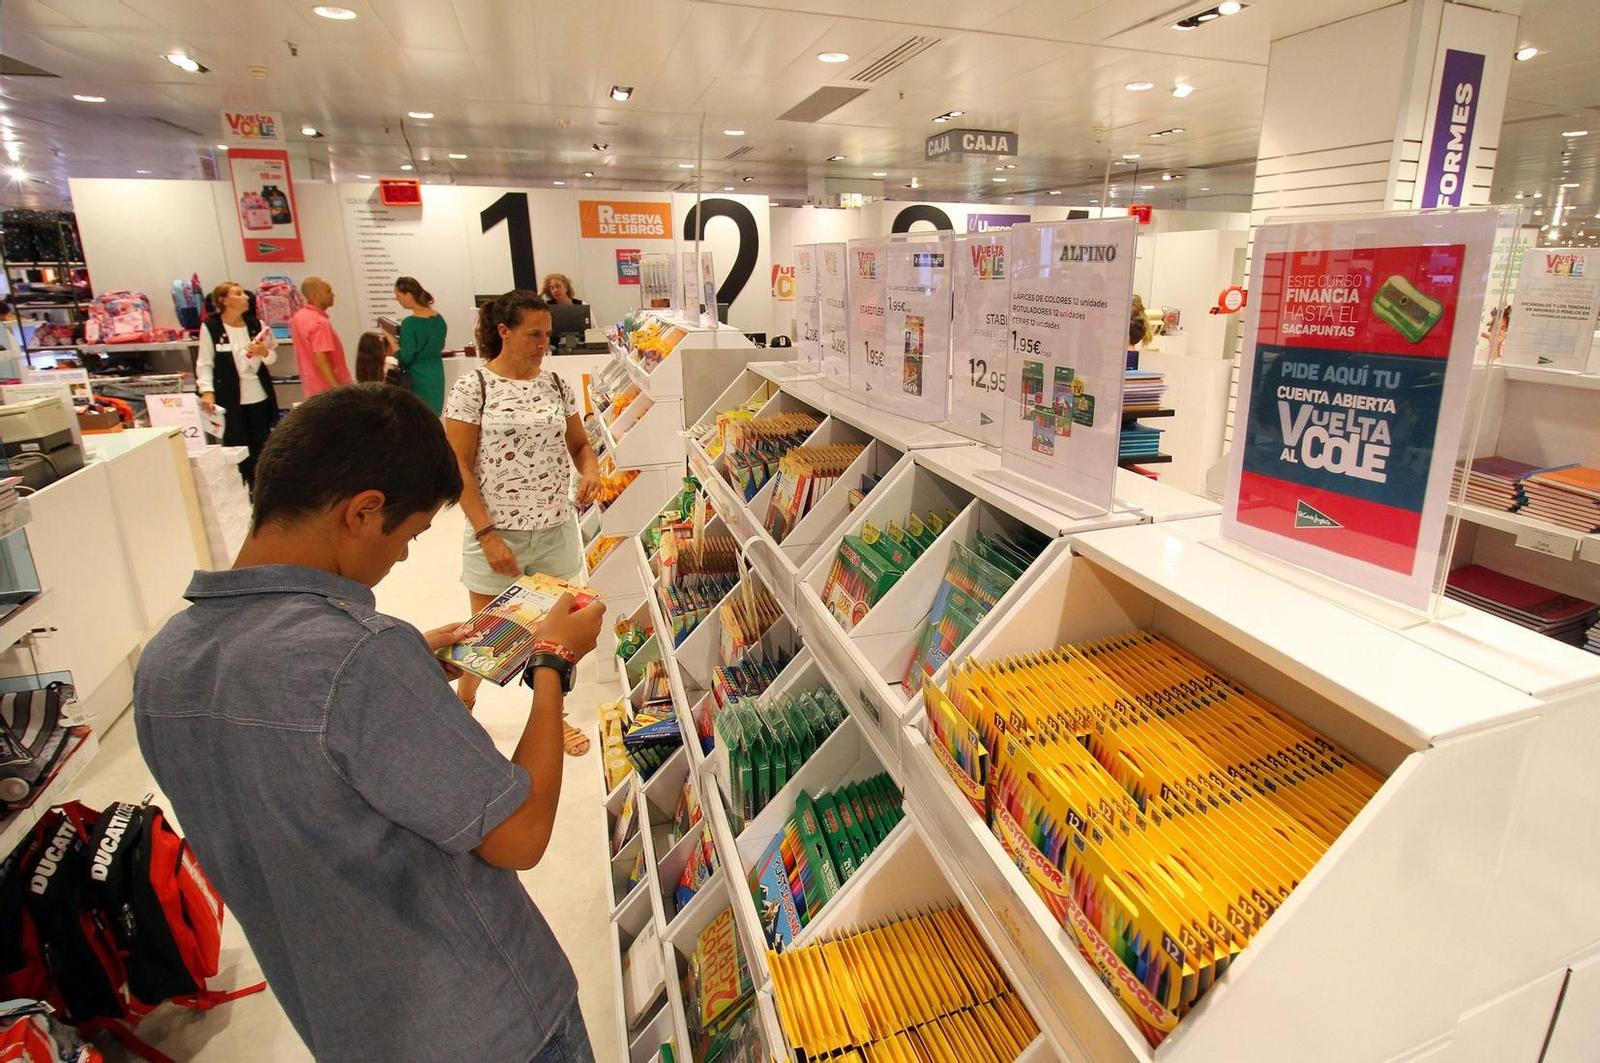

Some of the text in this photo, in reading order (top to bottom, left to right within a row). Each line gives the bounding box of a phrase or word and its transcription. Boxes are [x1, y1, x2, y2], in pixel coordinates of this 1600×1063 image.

[225, 113, 275, 129] VUELTA
[241, 121, 275, 136] COLE
[928, 136, 950, 156] CAJA
[962, 134, 1008, 152] CAJA
[1436, 82, 1474, 209] FORMES
[598, 205, 662, 224] RESERVA
[599, 224, 664, 235] DE LIBROS
[480, 192, 537, 294] 1
[684, 198, 759, 312] 2
[971, 244, 1004, 268] VUELTA
[1060, 244, 1116, 262] ALPINO
[1546, 254, 1585, 268] VUELTA
[979, 254, 1005, 280] COLE
[1554, 260, 1584, 275] COLE
[1288, 274, 1362, 287] ESTE CURSO
[888, 296, 906, 312] 1,95€
[1036, 294, 1043, 302] DE
[1045, 296, 1072, 305] COLORES
[1080, 299, 1107, 308] unidades
[1286, 288, 1360, 303] FINANCIA
[860, 304, 884, 317] STAEDTLER
[985, 313, 1008, 325] STABI
[1013, 305, 1052, 316] ROTULADORES
[1060, 310, 1085, 320] unidades
[1284, 305, 1359, 323] HASTA EL
[1037, 321, 1060, 330] unidades
[1282, 324, 1355, 337] SACAPUNTAS
[1012, 330, 1041, 355] 1,95€
[864, 341, 884, 367] 1,95€
[1281, 362, 1401, 389] PIDE AQUÍ TU
[1277, 385, 1396, 414] CUENTA ABIERTA
[1278, 400, 1392, 446] VUELTA
[1280, 425, 1390, 483] AL COLE
[996, 715, 1003, 730] 12
[1011, 714, 1020, 729] 12
[1049, 718, 1057, 730] 12
[969, 731, 977, 747] 12
[1069, 812, 1080, 828] 12
[1088, 806, 1098, 822] 12
[1101, 801, 1111, 820] 12
[31, 814, 78, 895] DUCATI
[91, 814, 131, 882] DUCATI
[995, 801, 1063, 891] PLASTIDECOR
[1241, 900, 1255, 923] 12
[1254, 894, 1269, 917] 12
[1210, 917, 1226, 940] 12
[1230, 909, 1245, 933] 12
[1182, 929, 1197, 954] 12
[1195, 924, 1210, 947] 12
[1164, 936, 1180, 962] 12
[1067, 900, 1165, 1025] PLASTIDECOR
